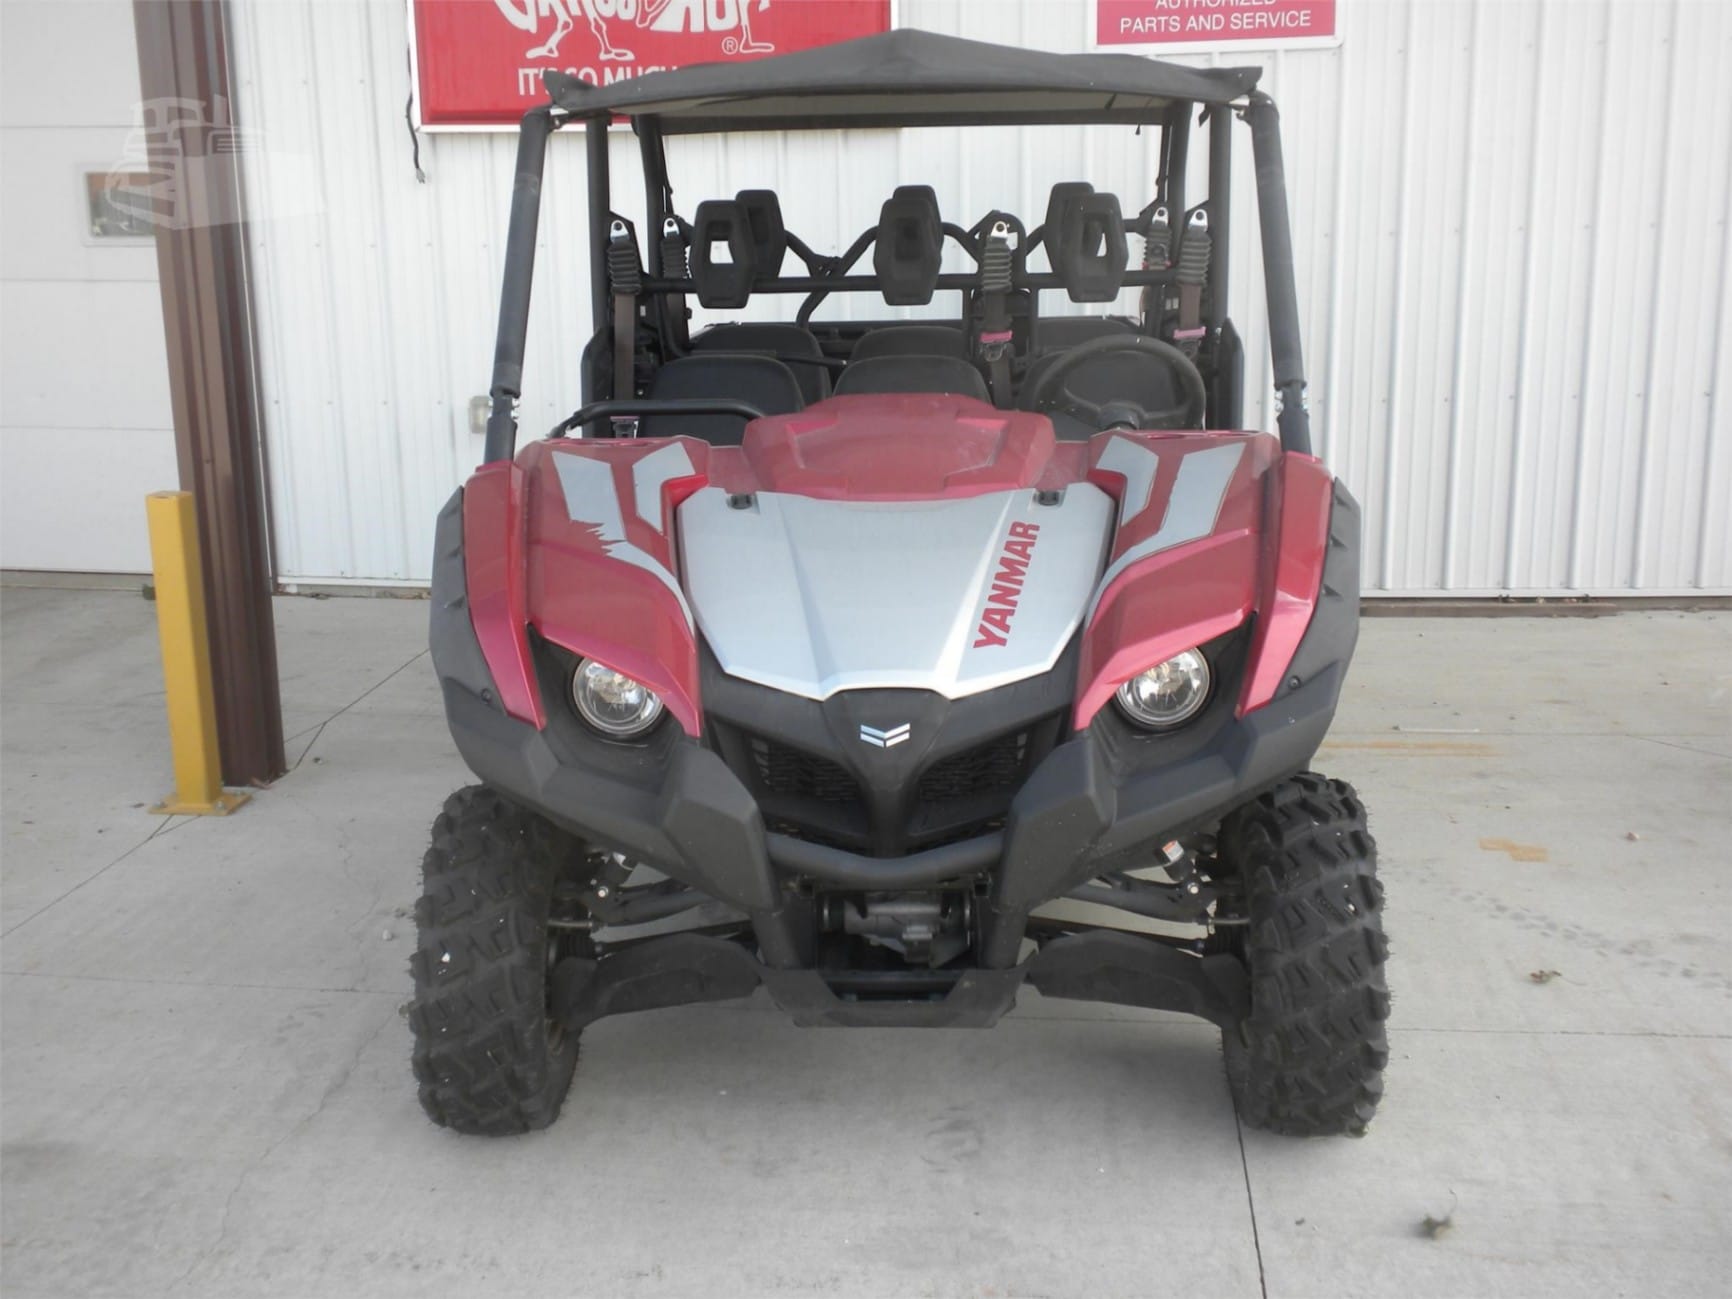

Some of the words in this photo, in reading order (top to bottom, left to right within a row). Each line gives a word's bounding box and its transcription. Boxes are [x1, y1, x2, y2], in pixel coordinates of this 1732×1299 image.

[1155, 0, 1276, 9] AUTHO
[1120, 16, 1181, 33] PARTS
[1186, 14, 1224, 31] AND
[1230, 10, 1311, 29] SERVICE
[518, 67, 557, 96] IT'
[564, 67, 598, 88] O
[973, 521, 1040, 648] YANMAR
